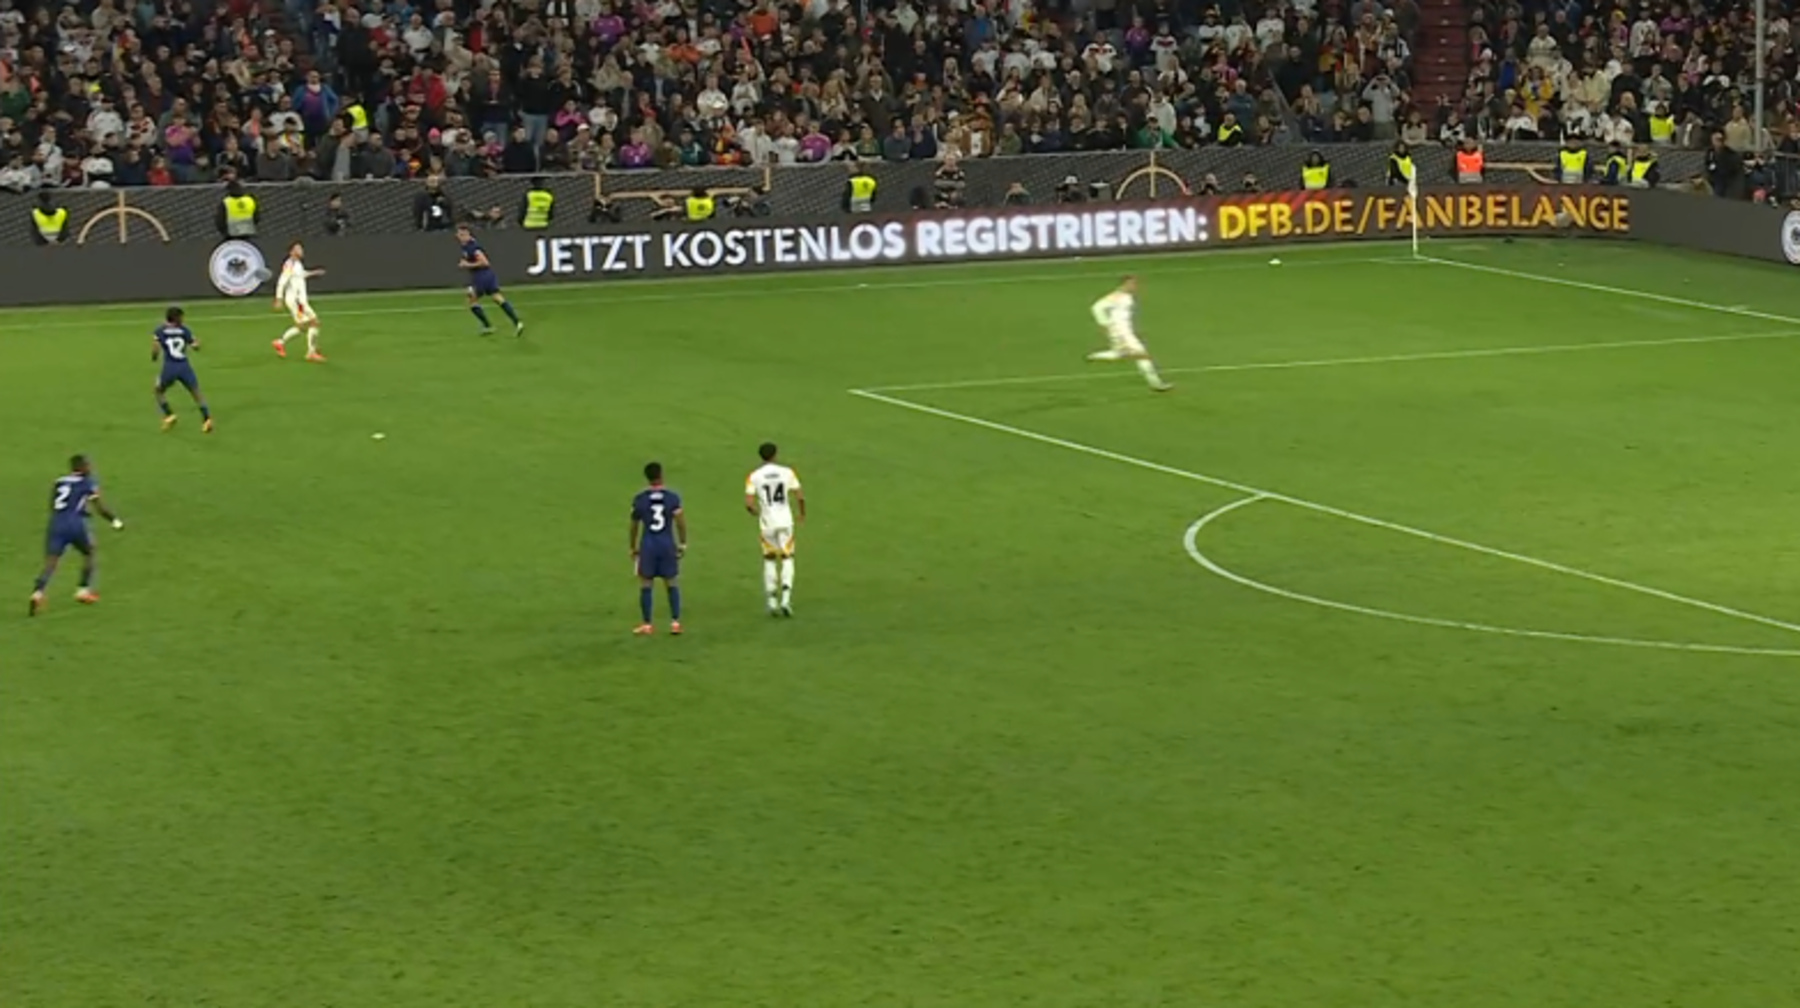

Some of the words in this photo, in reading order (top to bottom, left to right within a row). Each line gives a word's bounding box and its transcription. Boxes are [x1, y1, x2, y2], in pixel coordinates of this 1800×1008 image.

[527, 234, 651, 274] JETZT
[663, 222, 905, 267] KOSTENLOS
[915, 206, 1208, 257] REGISTRIEREN:
[1218, 194, 1630, 239] DFB.DE/FANBELANGE
[165, 336, 186, 359] 12
[54, 485, 71, 509] 2
[761, 482, 785, 506] 14
[649, 504, 665, 531] 3
